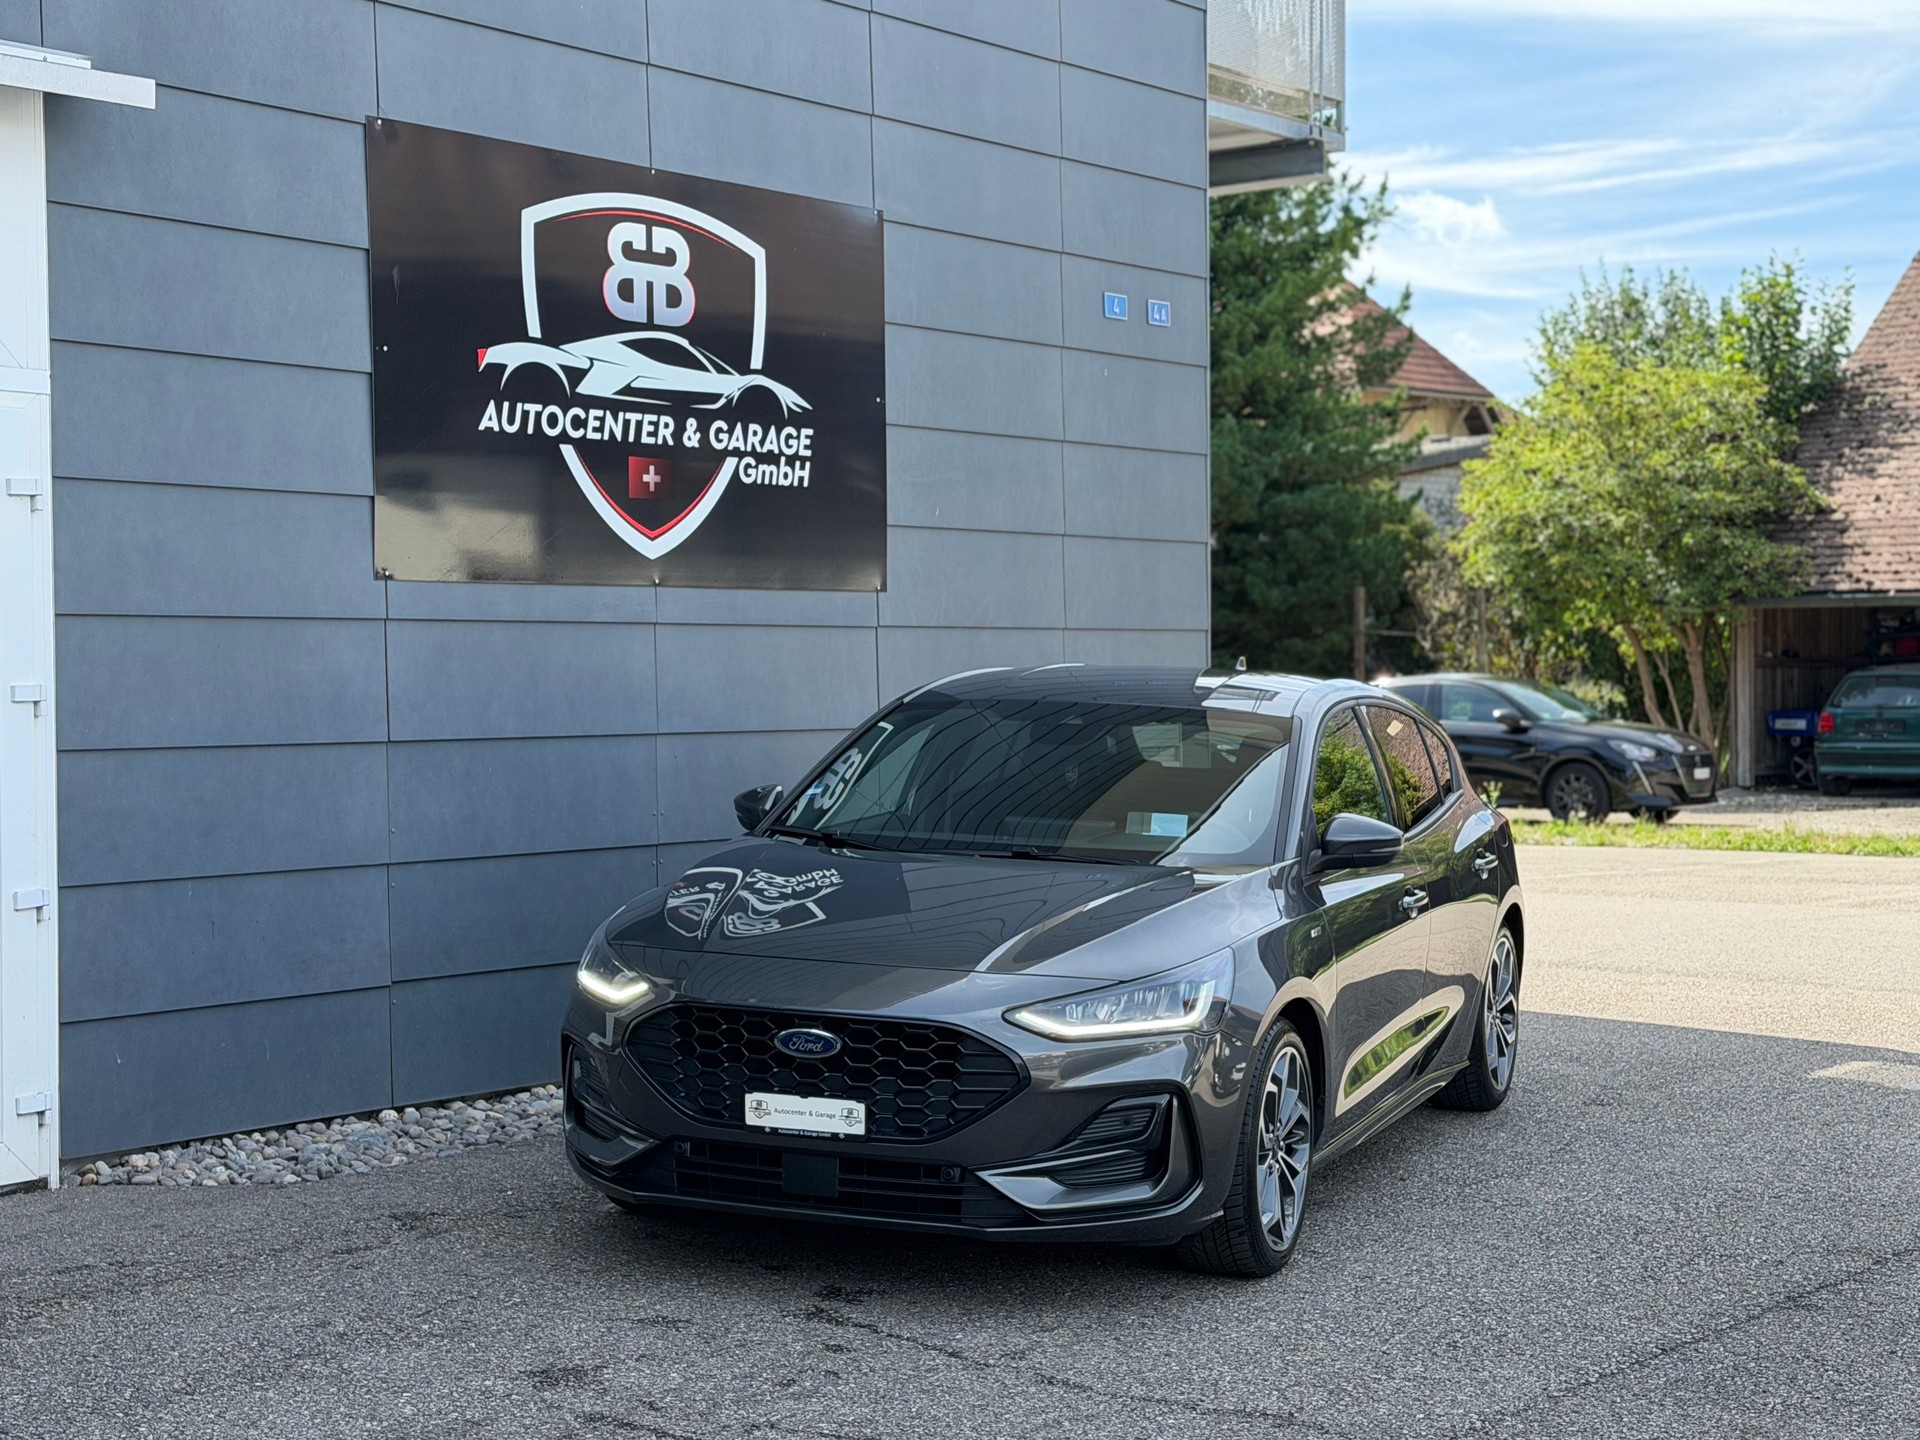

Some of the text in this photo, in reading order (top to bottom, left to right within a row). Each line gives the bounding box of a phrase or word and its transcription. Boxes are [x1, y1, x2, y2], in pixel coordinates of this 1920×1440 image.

[1154, 304, 1166, 321] 4A
[477, 398, 814, 457] AUTOCENTER & GARAGE
[738, 456, 811, 488] GmbH
[788, 1034, 824, 1052] Ford
[773, 1107, 807, 1117] Autocenter
[815, 1110, 837, 1120] Garage
